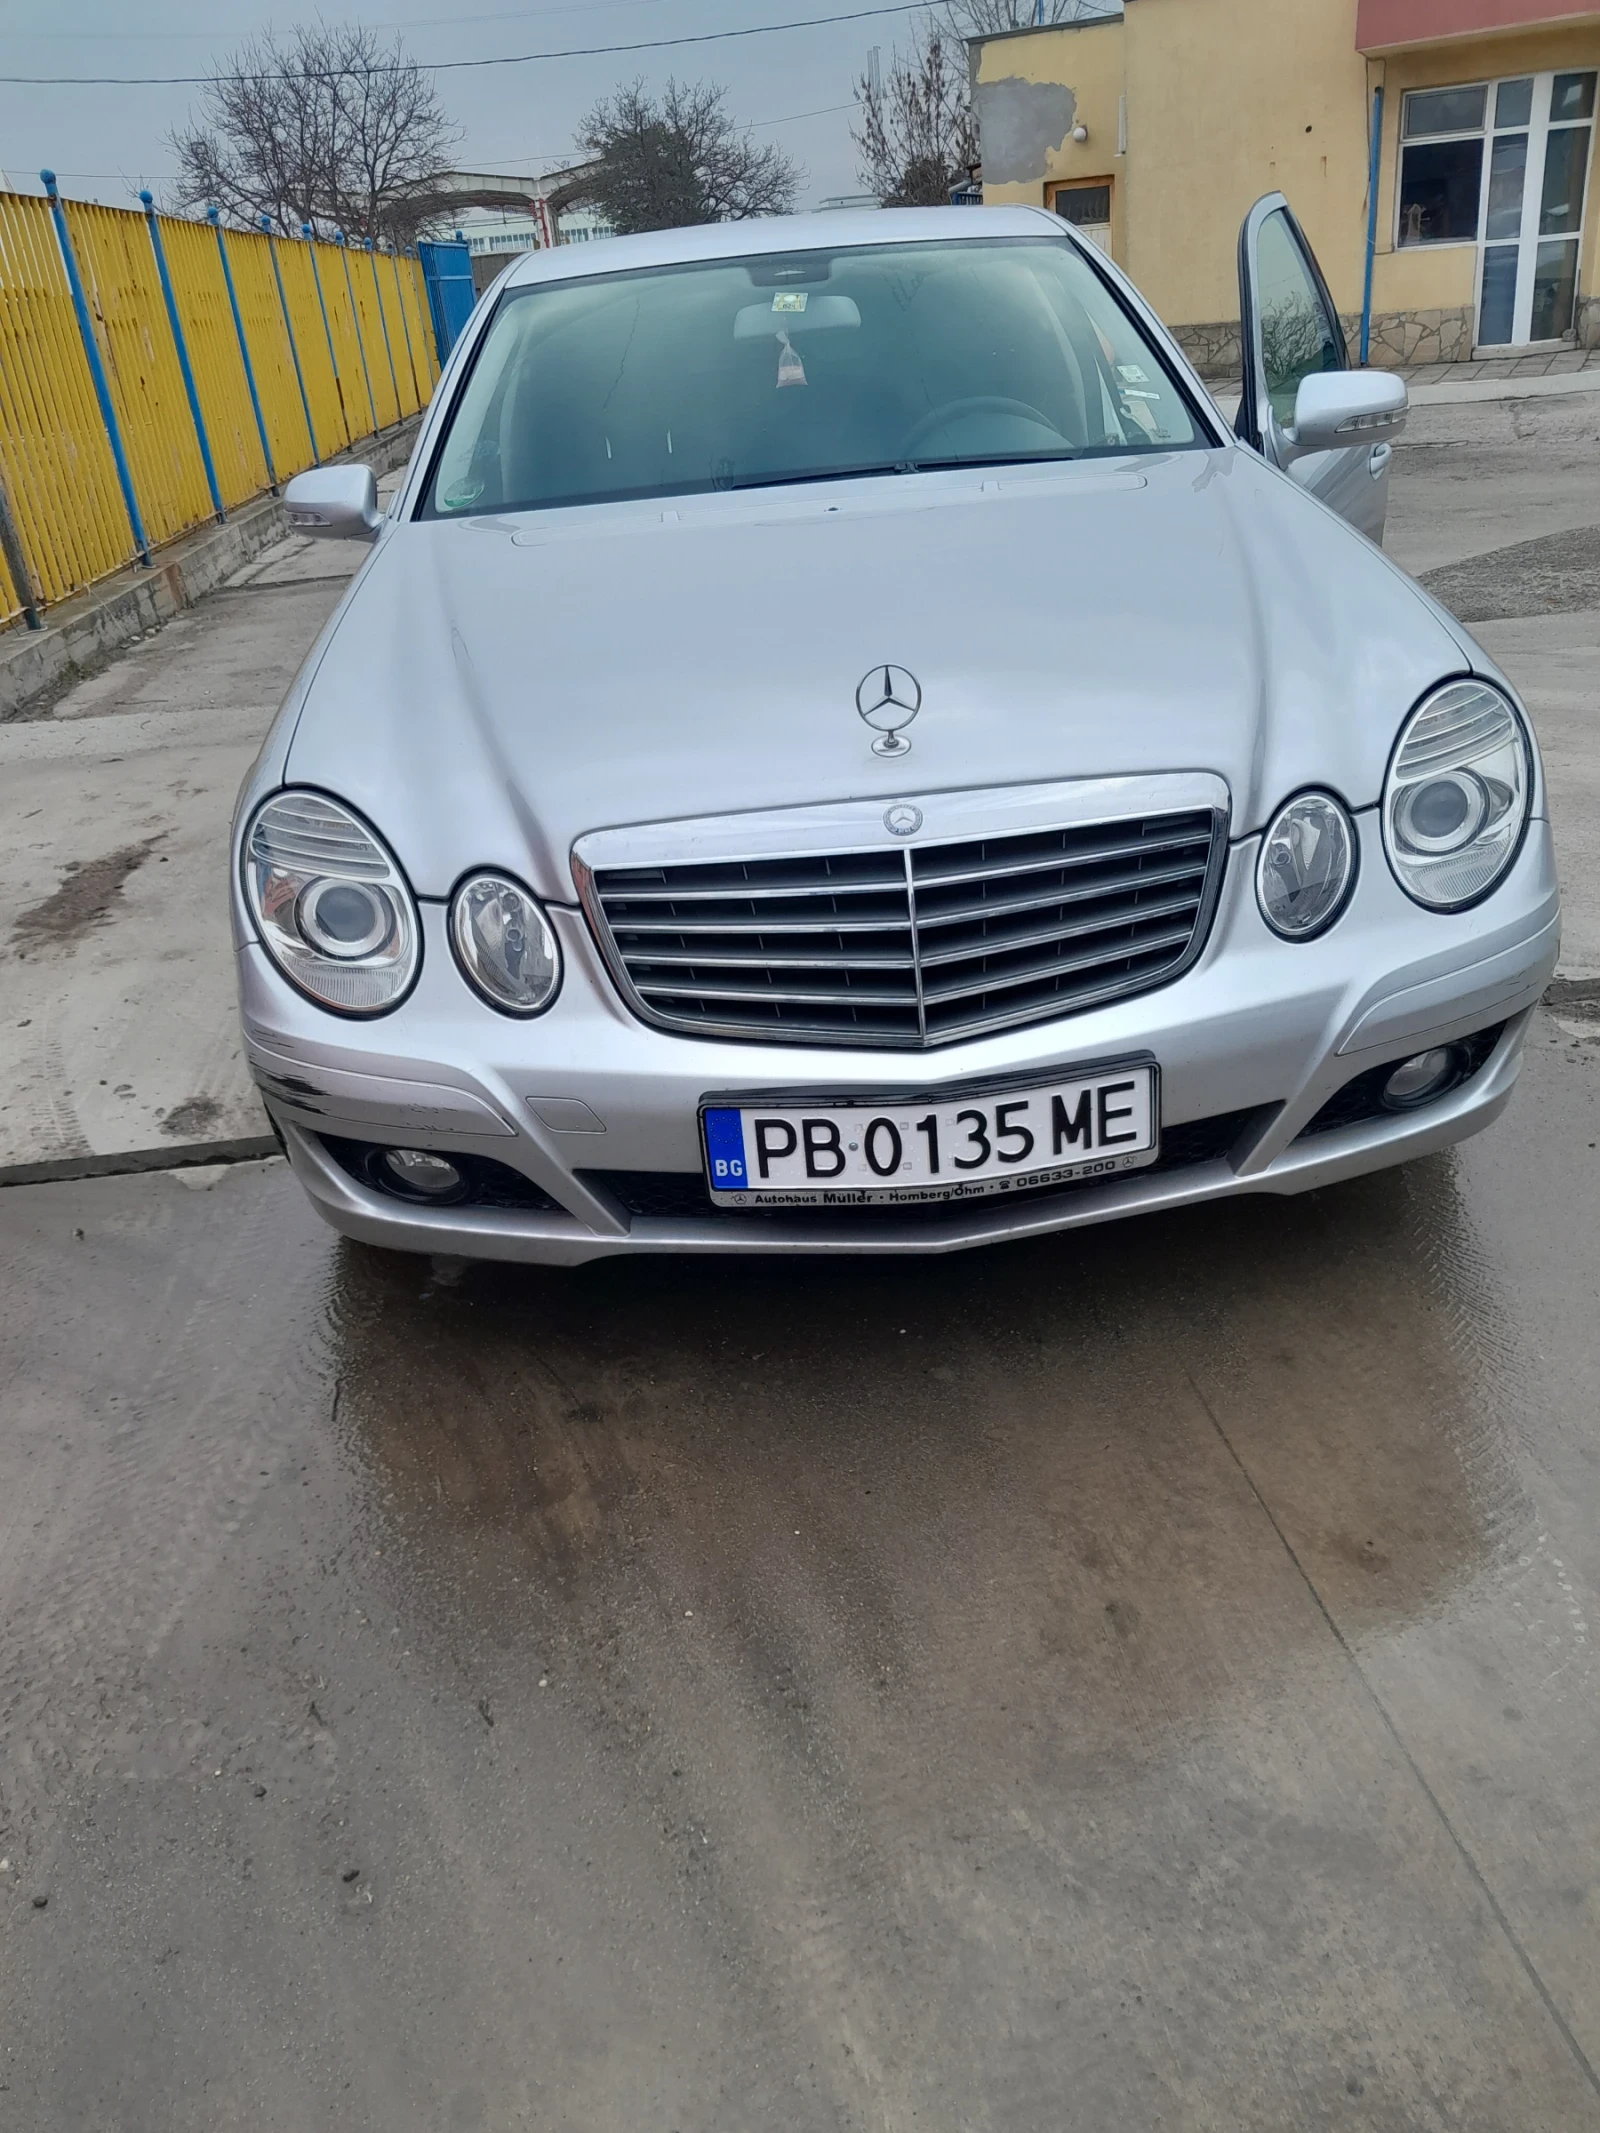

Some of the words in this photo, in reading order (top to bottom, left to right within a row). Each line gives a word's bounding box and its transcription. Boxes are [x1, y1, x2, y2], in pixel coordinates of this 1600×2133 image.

[754, 1117, 846, 1179] PB
[864, 1100, 1035, 1177] 0135
[1051, 1080, 1138, 1156] ME
[715, 1159, 743, 1177] BG
[755, 1193, 817, 1204] Autohaus
[823, 1191, 873, 1204] Müller
[1016, 1160, 1116, 1188] 06633-200
